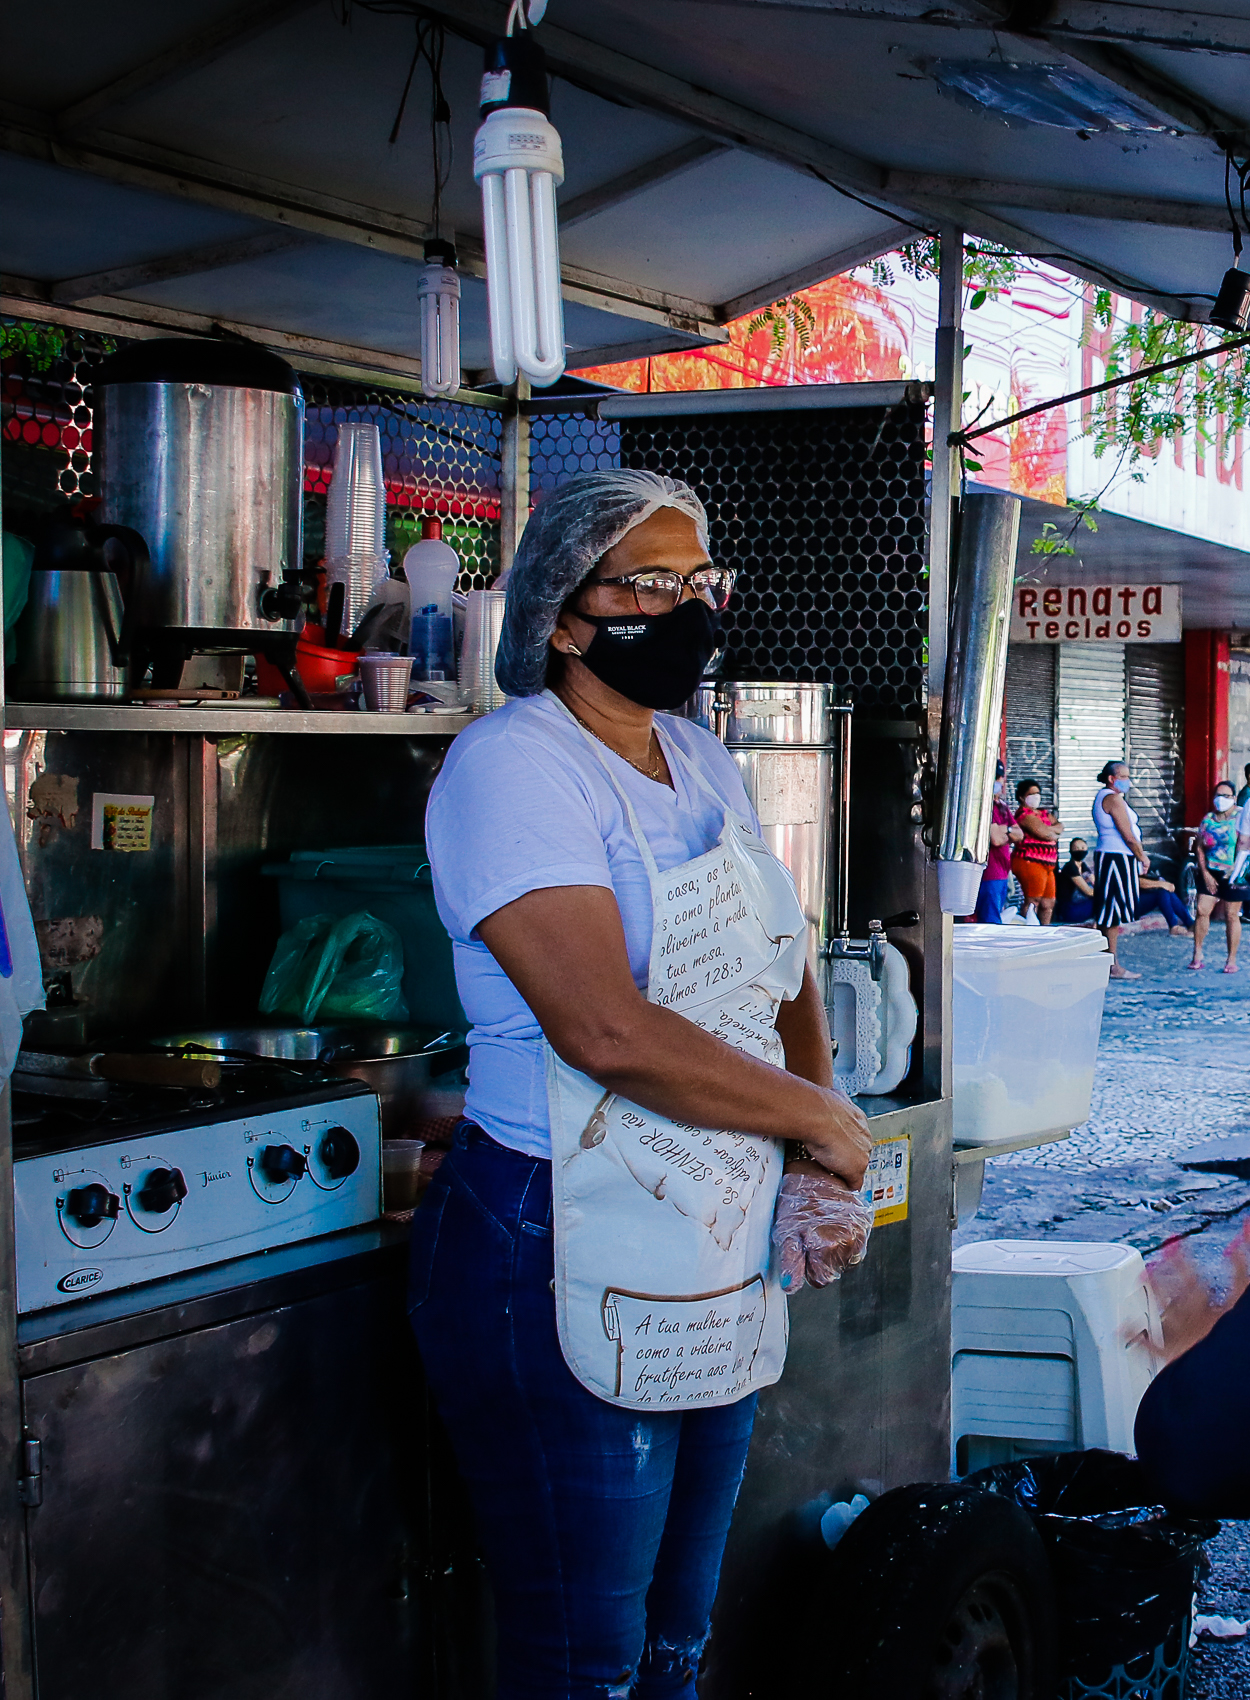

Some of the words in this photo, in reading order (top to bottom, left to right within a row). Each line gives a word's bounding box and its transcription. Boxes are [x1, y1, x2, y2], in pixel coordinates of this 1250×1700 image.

[1018, 586, 1162, 617] Renata
[667, 879, 700, 901] casa;
[706, 868, 718, 884] os
[674, 904, 702, 926] como
[713, 916, 720, 932] à
[725, 901, 748, 928] roda
[666, 962, 688, 980] tua
[692, 946, 725, 969] mesa.
[704, 957, 743, 987] 128:3
[720, 1009, 770, 1050] entinela.
[621, 1112, 646, 1129] não
[638, 1127, 714, 1182] SENHOR
[702, 1136, 712, 1146] a
[196, 1170, 232, 1188] Júnior
[713, 1148, 750, 1182] edificar
[714, 1178, 723, 1186] o
[722, 1186, 739, 1205] Se
[64, 1271, 100, 1288] CLARICE
[634, 1314, 652, 1336] A
[657, 1318, 680, 1334] tua
[686, 1309, 732, 1332] mulher
[636, 1347, 670, 1360] como
[676, 1346, 684, 1358] a
[690, 1335, 732, 1356] videira
[634, 1362, 702, 1392] frutífera
[706, 1364, 728, 1377] aos
